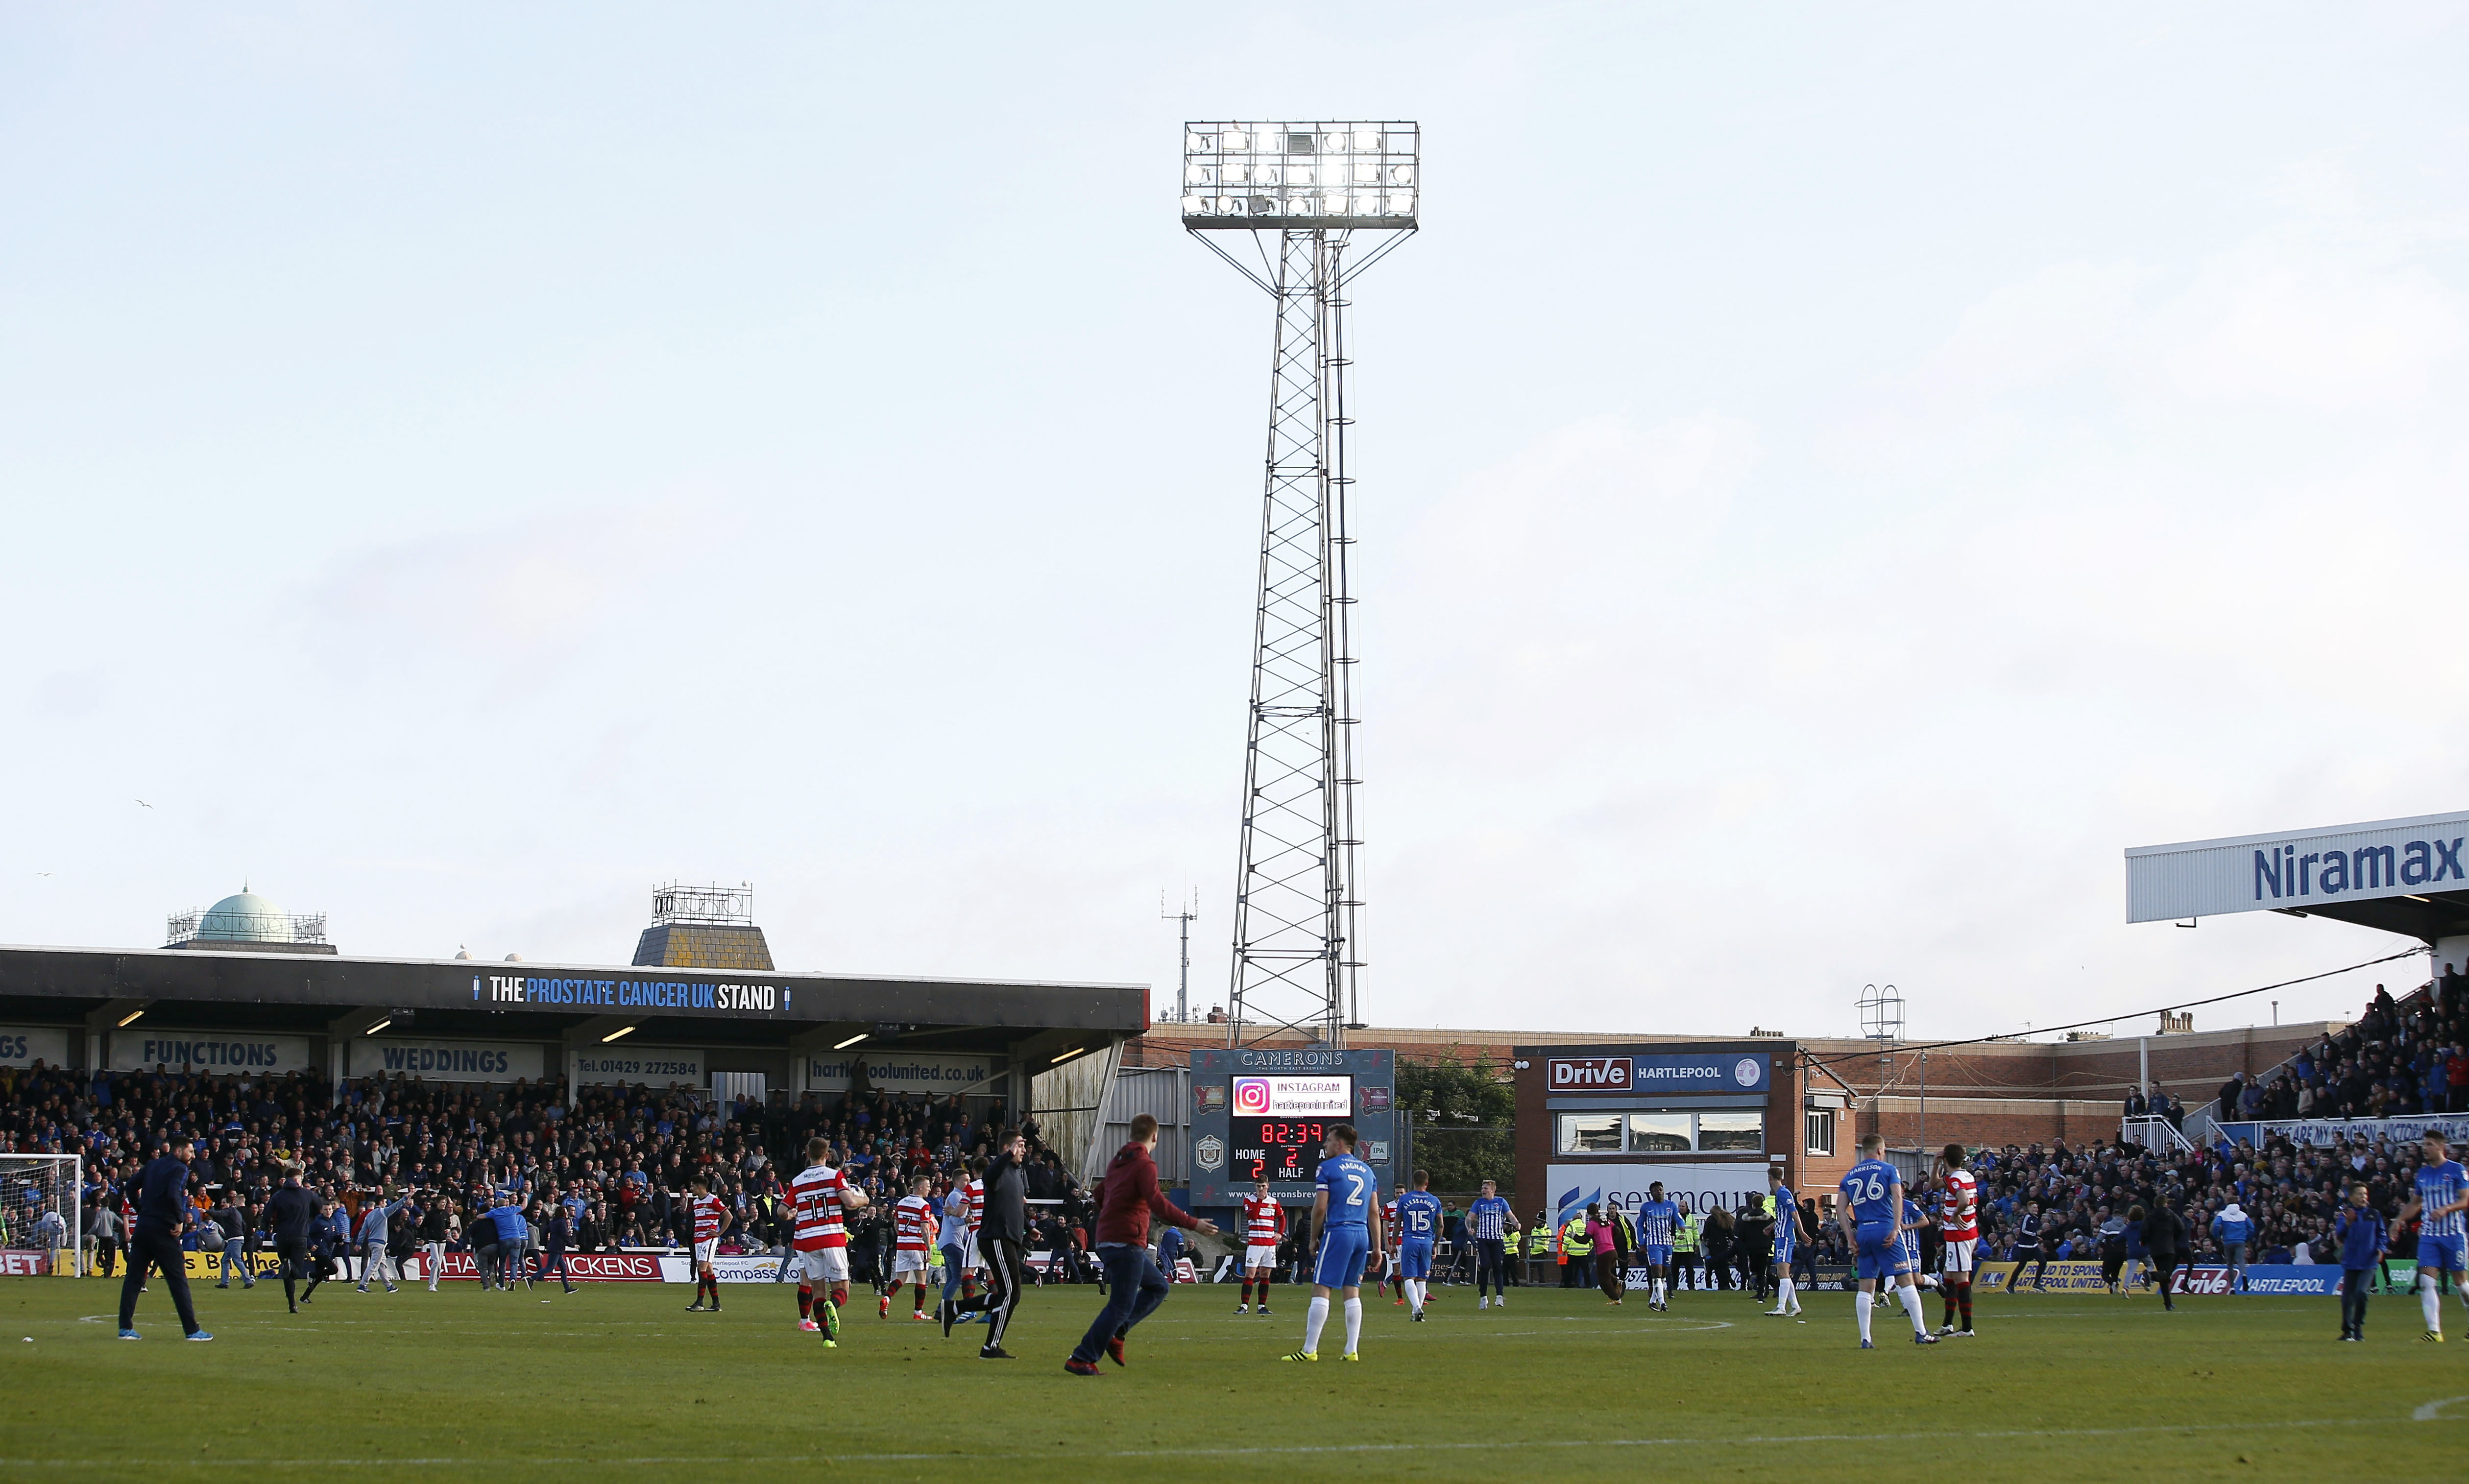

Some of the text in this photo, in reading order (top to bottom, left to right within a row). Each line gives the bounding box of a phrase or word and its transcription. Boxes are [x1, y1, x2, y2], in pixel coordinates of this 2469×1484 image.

[2254, 837, 2465, 901] Niramax
[489, 976, 775, 1010] THE PROSTATE CANCER UK STAND
[144, 1039, 277, 1066] FUNCTIONS
[383, 1047, 508, 1074] WEDDINGS
[1241, 1052, 1343, 1066] CAMERONS
[578, 1059, 698, 1076] Tel. 01429 272584
[813, 1060, 985, 1081] hartloolunited.co.uk
[1555, 1059, 1721, 1083] Drive HARTLEPOOL
[1277, 1083, 1340, 1092] INSTAGRAM
[1273, 1100, 1347, 1111] hartlepoolunited
[1235, 1149, 1265, 1160] HOME
[1278, 1167, 1304, 1178] HALF
[1339, 1162, 1367, 1173] MAGNAY
[1849, 1164, 1882, 1175] HARRISON
[1346, 1174, 1364, 1206] 2
[1847, 1173, 1884, 1206] 26
[805, 1193, 829, 1221] 11
[902, 1215, 912, 1234] 7
[1408, 1210, 1430, 1231] 15
[1948, 1250, 1953, 1262] 9
[552, 1256, 653, 1275] ICKENS
[713, 1268, 777, 1281] Compass
[2023, 1265, 2057, 1275] PRUD
[2058, 1265, 2071, 1275] TO
[1980, 1272, 2007, 1285] MKM
[2014, 1277, 2069, 1288] ARTEPOOL
[2071, 1278, 2106, 1289] UNITED
[2170, 1270, 2227, 1294] Drive
